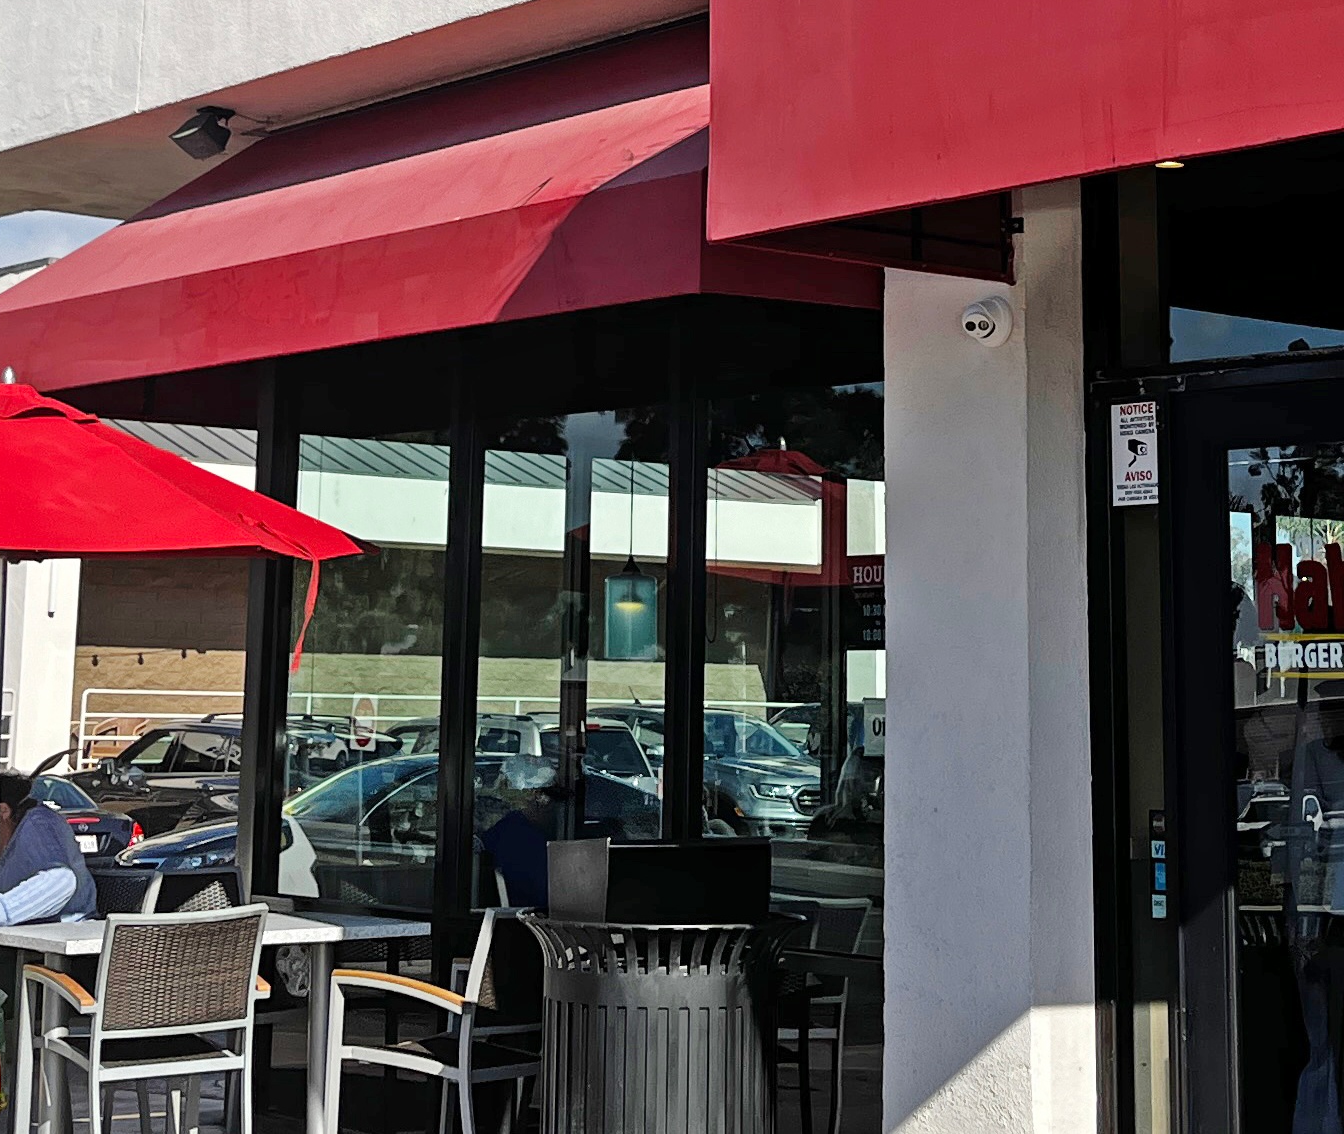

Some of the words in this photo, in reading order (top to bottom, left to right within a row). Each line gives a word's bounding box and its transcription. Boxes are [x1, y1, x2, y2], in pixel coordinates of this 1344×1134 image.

[1119, 403, 1154, 416] NOTICE
[1125, 470, 1153, 482] AVISO
[852, 565, 885, 584] HOU
[1264, 642, 1344, 669] BURGER
